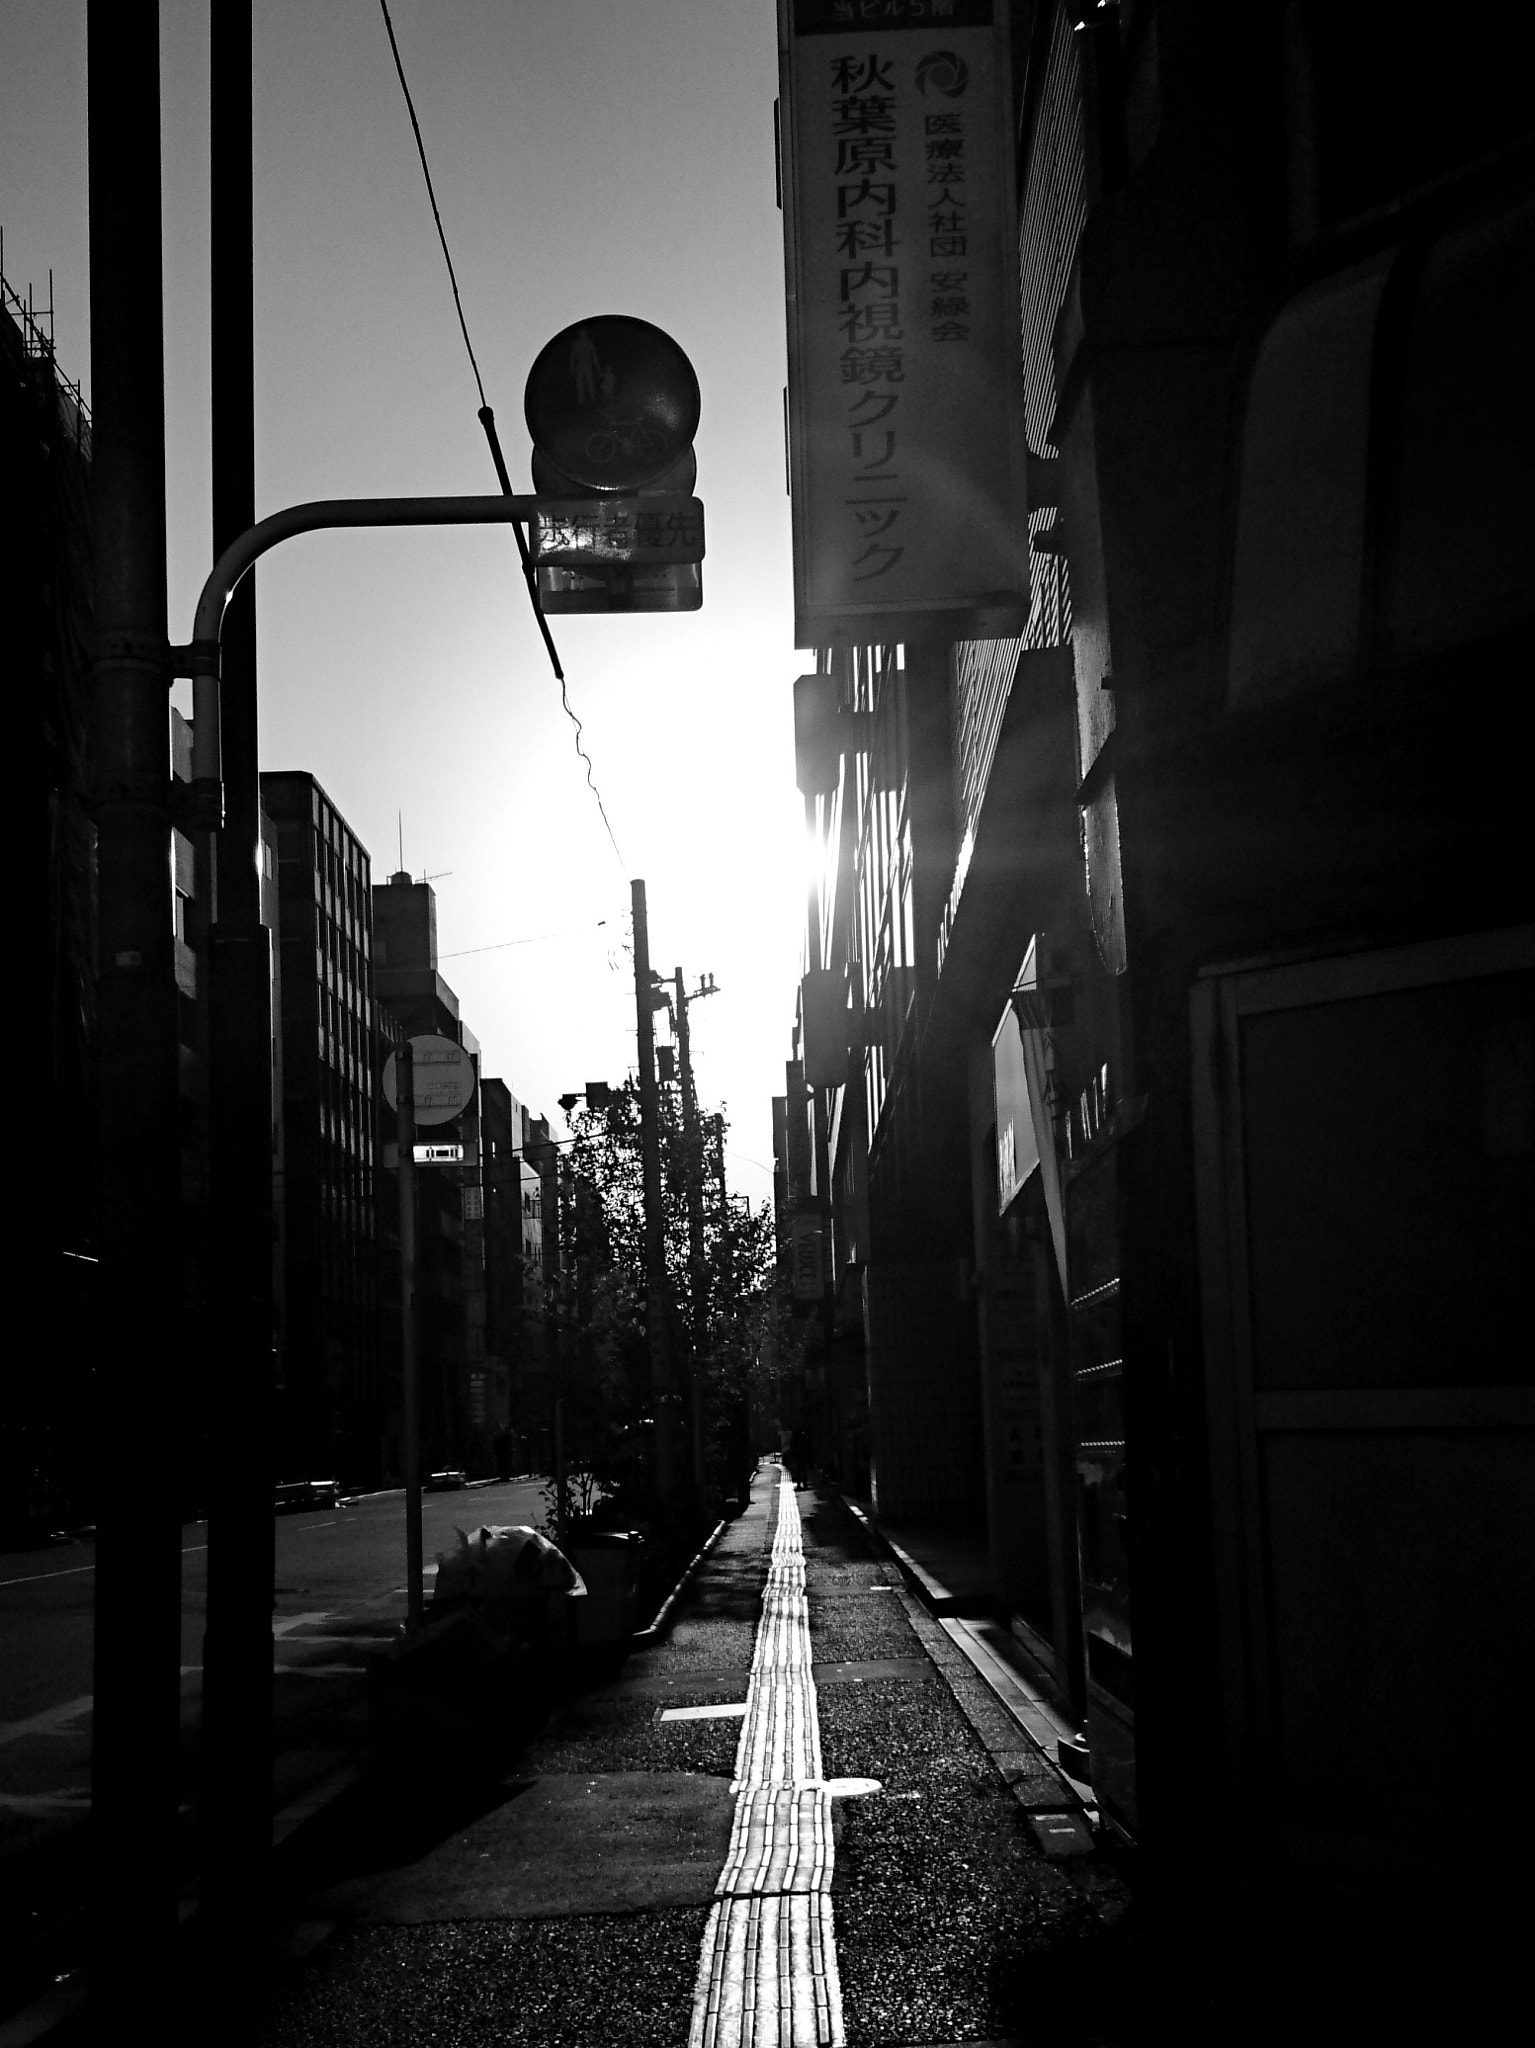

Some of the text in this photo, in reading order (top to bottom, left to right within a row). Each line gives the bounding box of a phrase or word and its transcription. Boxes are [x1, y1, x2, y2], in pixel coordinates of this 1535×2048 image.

[830, 54, 906, 582] 秋葉原内科内視鏡クリニック
[925, 113, 967, 258] 医療法人社団
